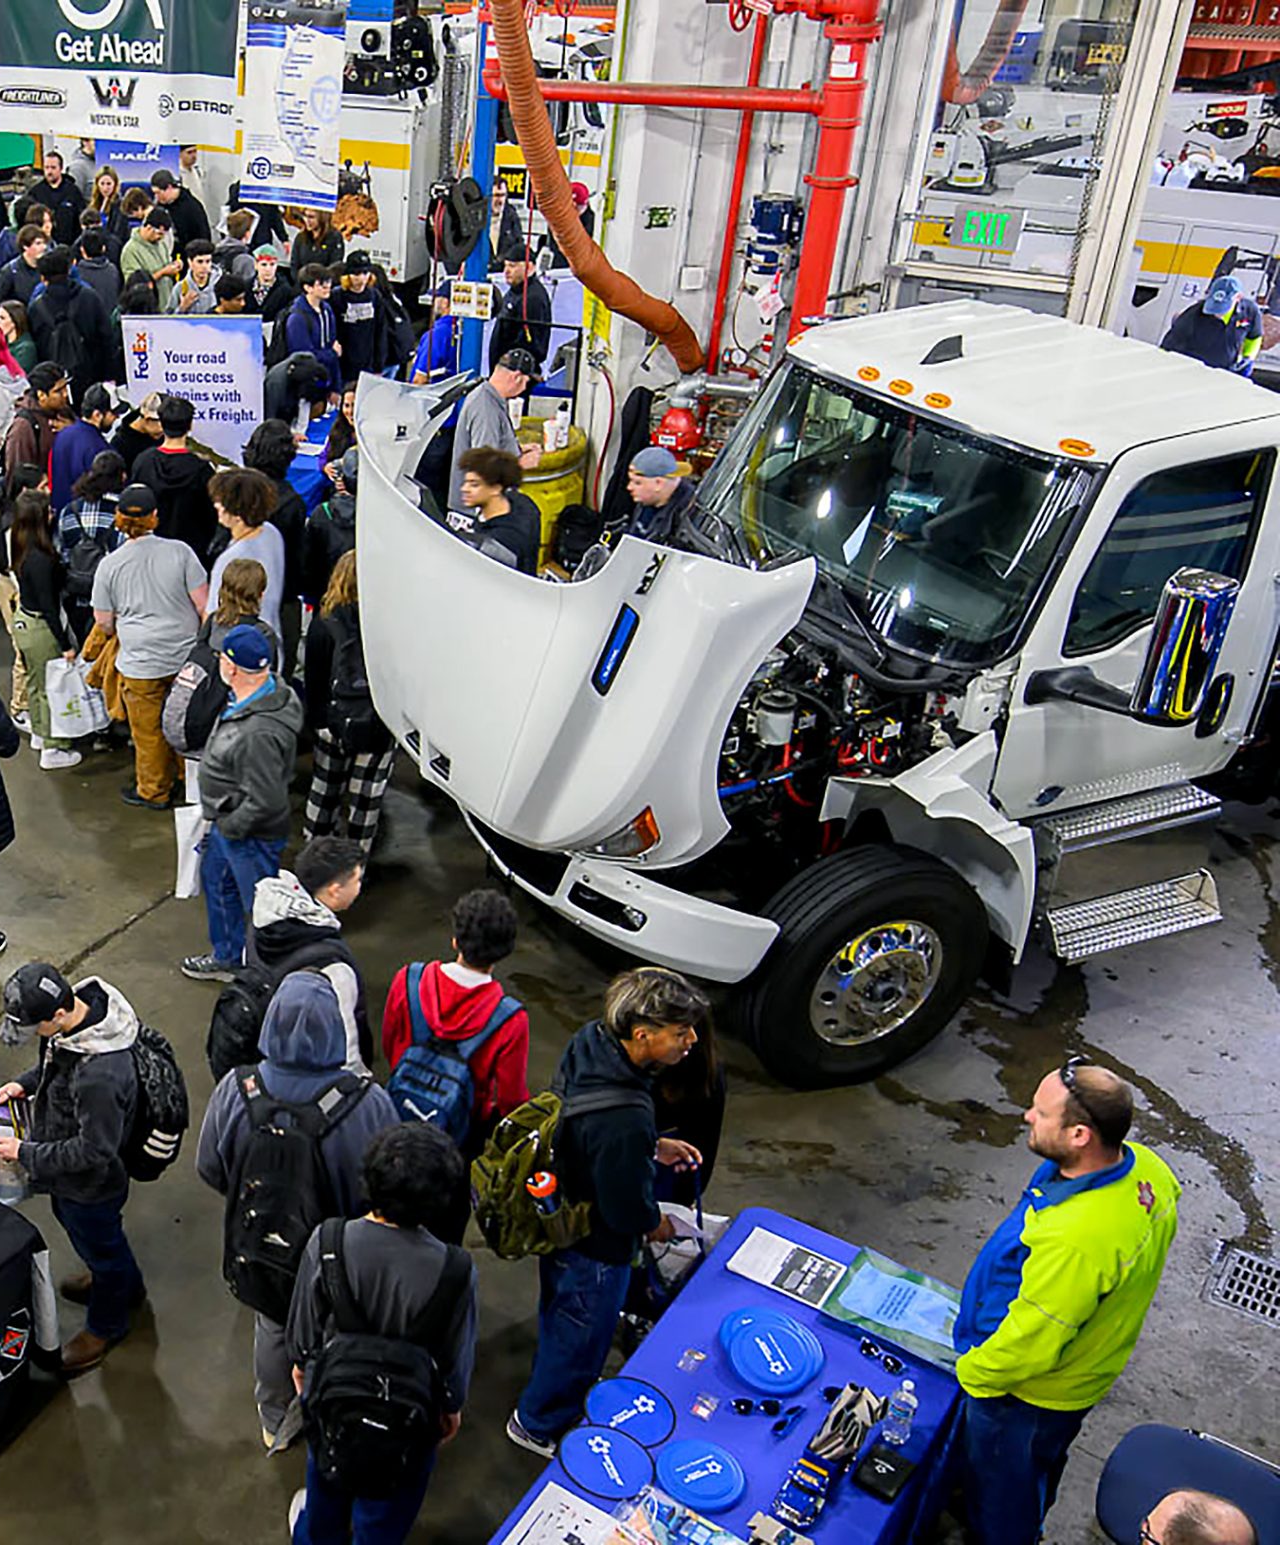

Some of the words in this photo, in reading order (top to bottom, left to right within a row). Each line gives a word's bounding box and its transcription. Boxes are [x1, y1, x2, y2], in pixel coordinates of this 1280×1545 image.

[55, 32, 96, 63] Get
[99, 33, 164, 65] Ahead
[1, 90, 61, 104] FREIGHTLINER
[89, 113, 121, 126] WESTERN
[123, 115, 140, 128] STAR
[962, 210, 1012, 247] EXIT
[133, 331, 149, 379] FedEx
[163, 350, 193, 364] Your
[196, 351, 226, 364] road
[165, 372, 178, 382] to
[181, 373, 234, 383] success
[212, 389, 241, 402] with
[209, 408, 257, 424] Freight.
